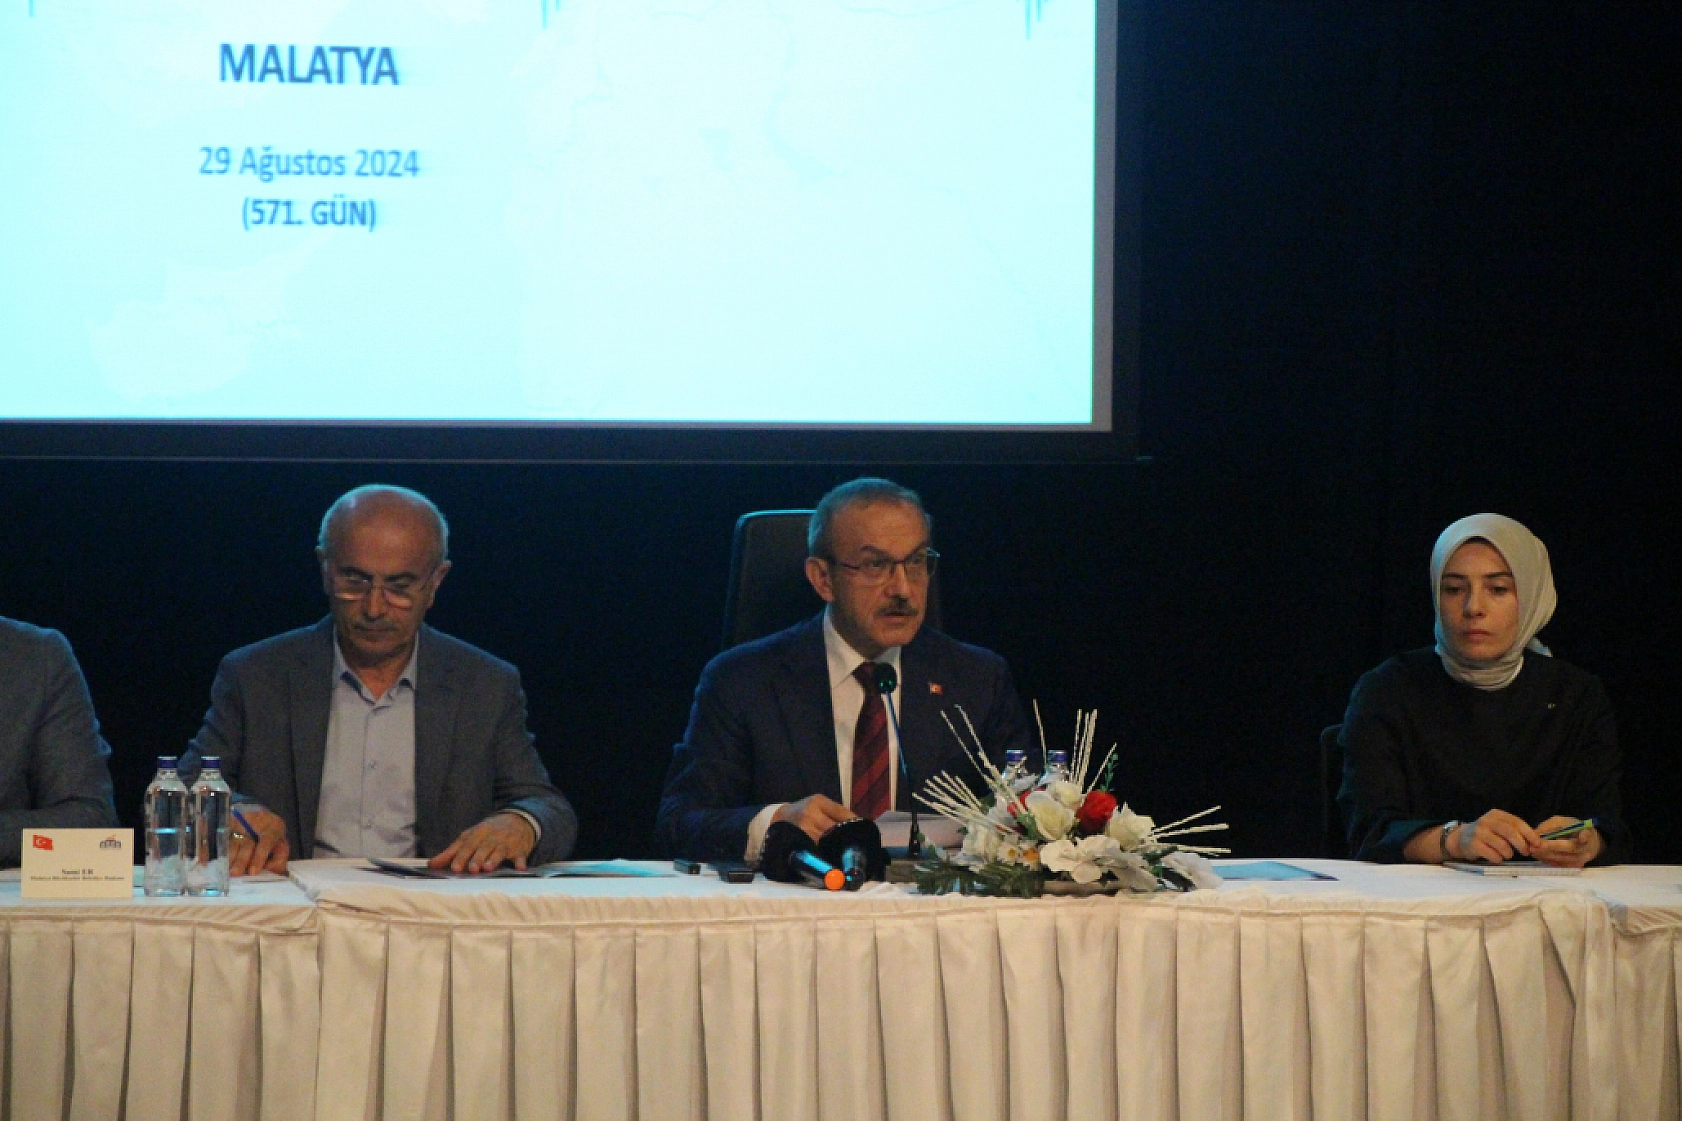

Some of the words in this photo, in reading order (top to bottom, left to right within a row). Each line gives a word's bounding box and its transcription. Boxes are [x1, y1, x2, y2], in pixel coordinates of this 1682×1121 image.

[220, 43, 399, 85] MALATYA
[199, 146, 230, 174] 29
[239, 145, 346, 184] Ağustos
[355, 149, 421, 177] 2024
[241, 196, 304, 232] (571.
[311, 194, 377, 232] GÜN)
